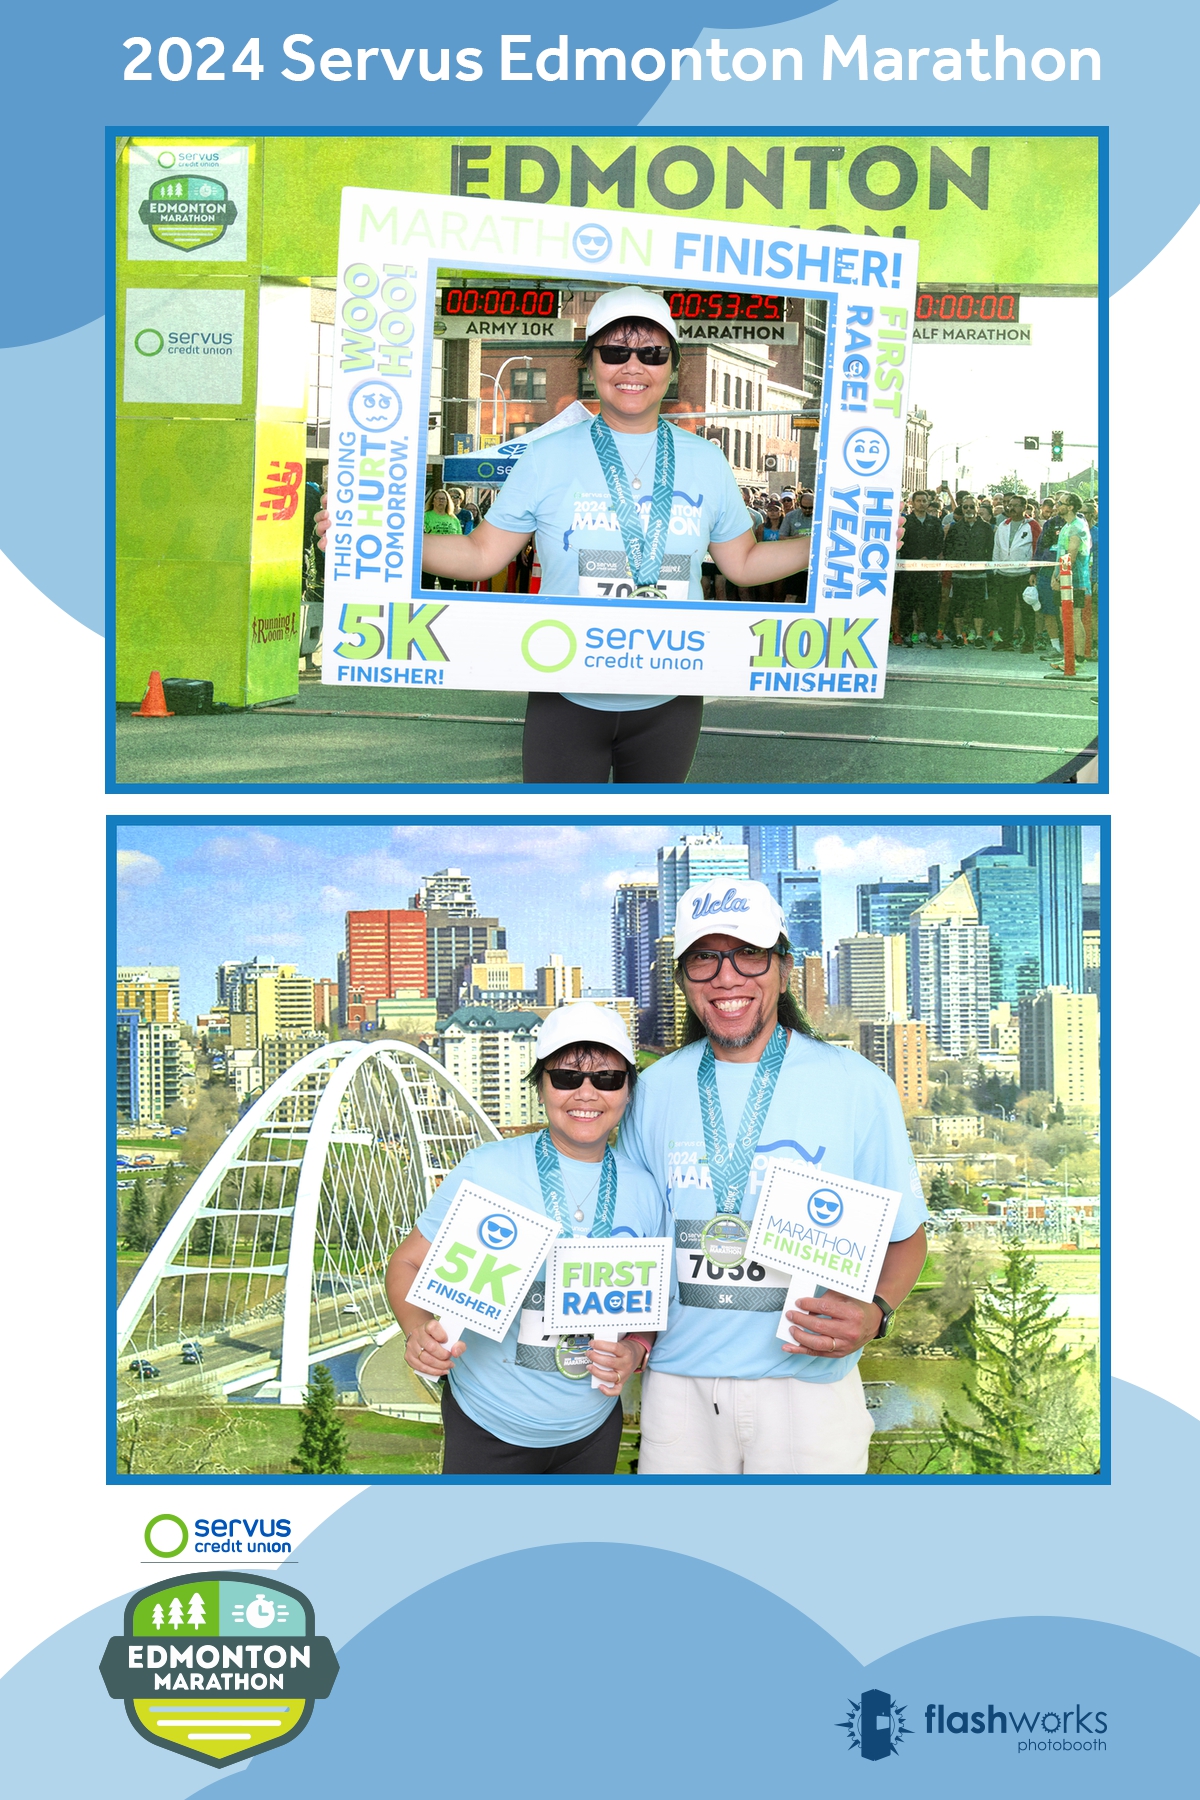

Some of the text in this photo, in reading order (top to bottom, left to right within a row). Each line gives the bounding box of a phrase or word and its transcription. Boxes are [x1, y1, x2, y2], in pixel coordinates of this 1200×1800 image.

[178, 152, 219, 161] servus
[450, 144, 990, 211] EDMONTON
[150, 203, 227, 214] EDMONTON
[160, 214, 215, 222] MARATHON
[673, 231, 903, 289] FINISHER!
[340, 262, 379, 374] WOO
[378, 263, 418, 378] HOO!
[466, 321, 554, 336] ARMY 10K
[678, 325, 785, 340] MARATHON
[913, 328, 1031, 341] ALF MARATHON
[168, 332, 233, 345] servus
[168, 345, 233, 355] credit union
[840, 304, 875, 413] RACE!
[873, 304, 909, 419] FIRST
[334, 431, 356, 581] THIS IS GOING
[355, 434, 386, 580] TO HURT
[384, 435, 409, 583] TOMORROW.
[574, 501, 607, 512] 2024
[821, 483, 860, 600] YEAH!
[856, 486, 894, 598] HECK
[333, 602, 450, 662] 5K
[585, 627, 705, 651] servus
[749, 617, 879, 669] 10K
[337, 665, 444, 685] FINISHER!
[584, 652, 704, 671] credit union
[749, 672, 877, 693] FINISHER!
[668, 1151, 697, 1165] 2024
[766, 1213, 867, 1260] MARATHON
[761, 1230, 862, 1278] FINISHER!
[434, 1241, 522, 1306] 5K
[562, 1261, 657, 1288] FIRST
[426, 1279, 502, 1321] FINISHER!
[562, 1290, 652, 1316] RACE!
[719, 1295, 733, 1304] 5K
